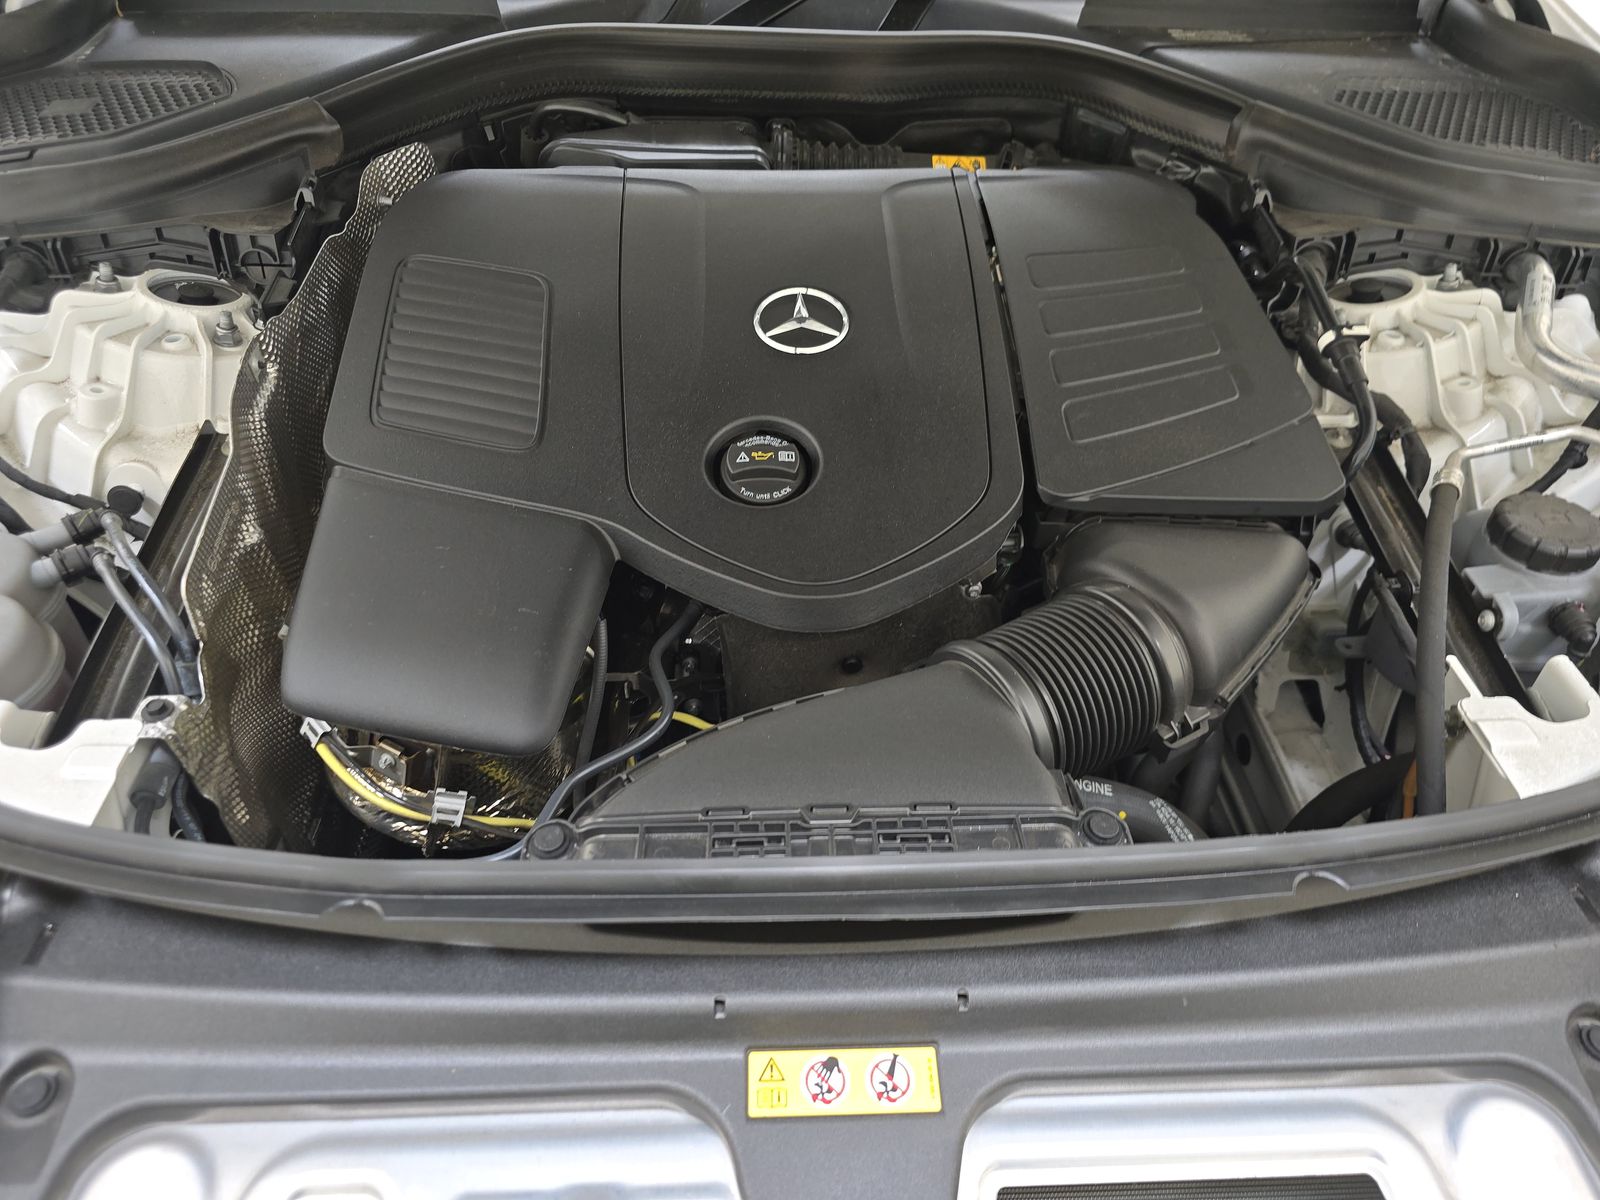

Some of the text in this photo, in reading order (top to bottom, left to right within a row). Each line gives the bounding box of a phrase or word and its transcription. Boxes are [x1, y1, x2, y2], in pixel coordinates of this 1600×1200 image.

[740, 485, 793, 500] Turn until CLICK
[1073, 778, 1113, 797] NGINE
